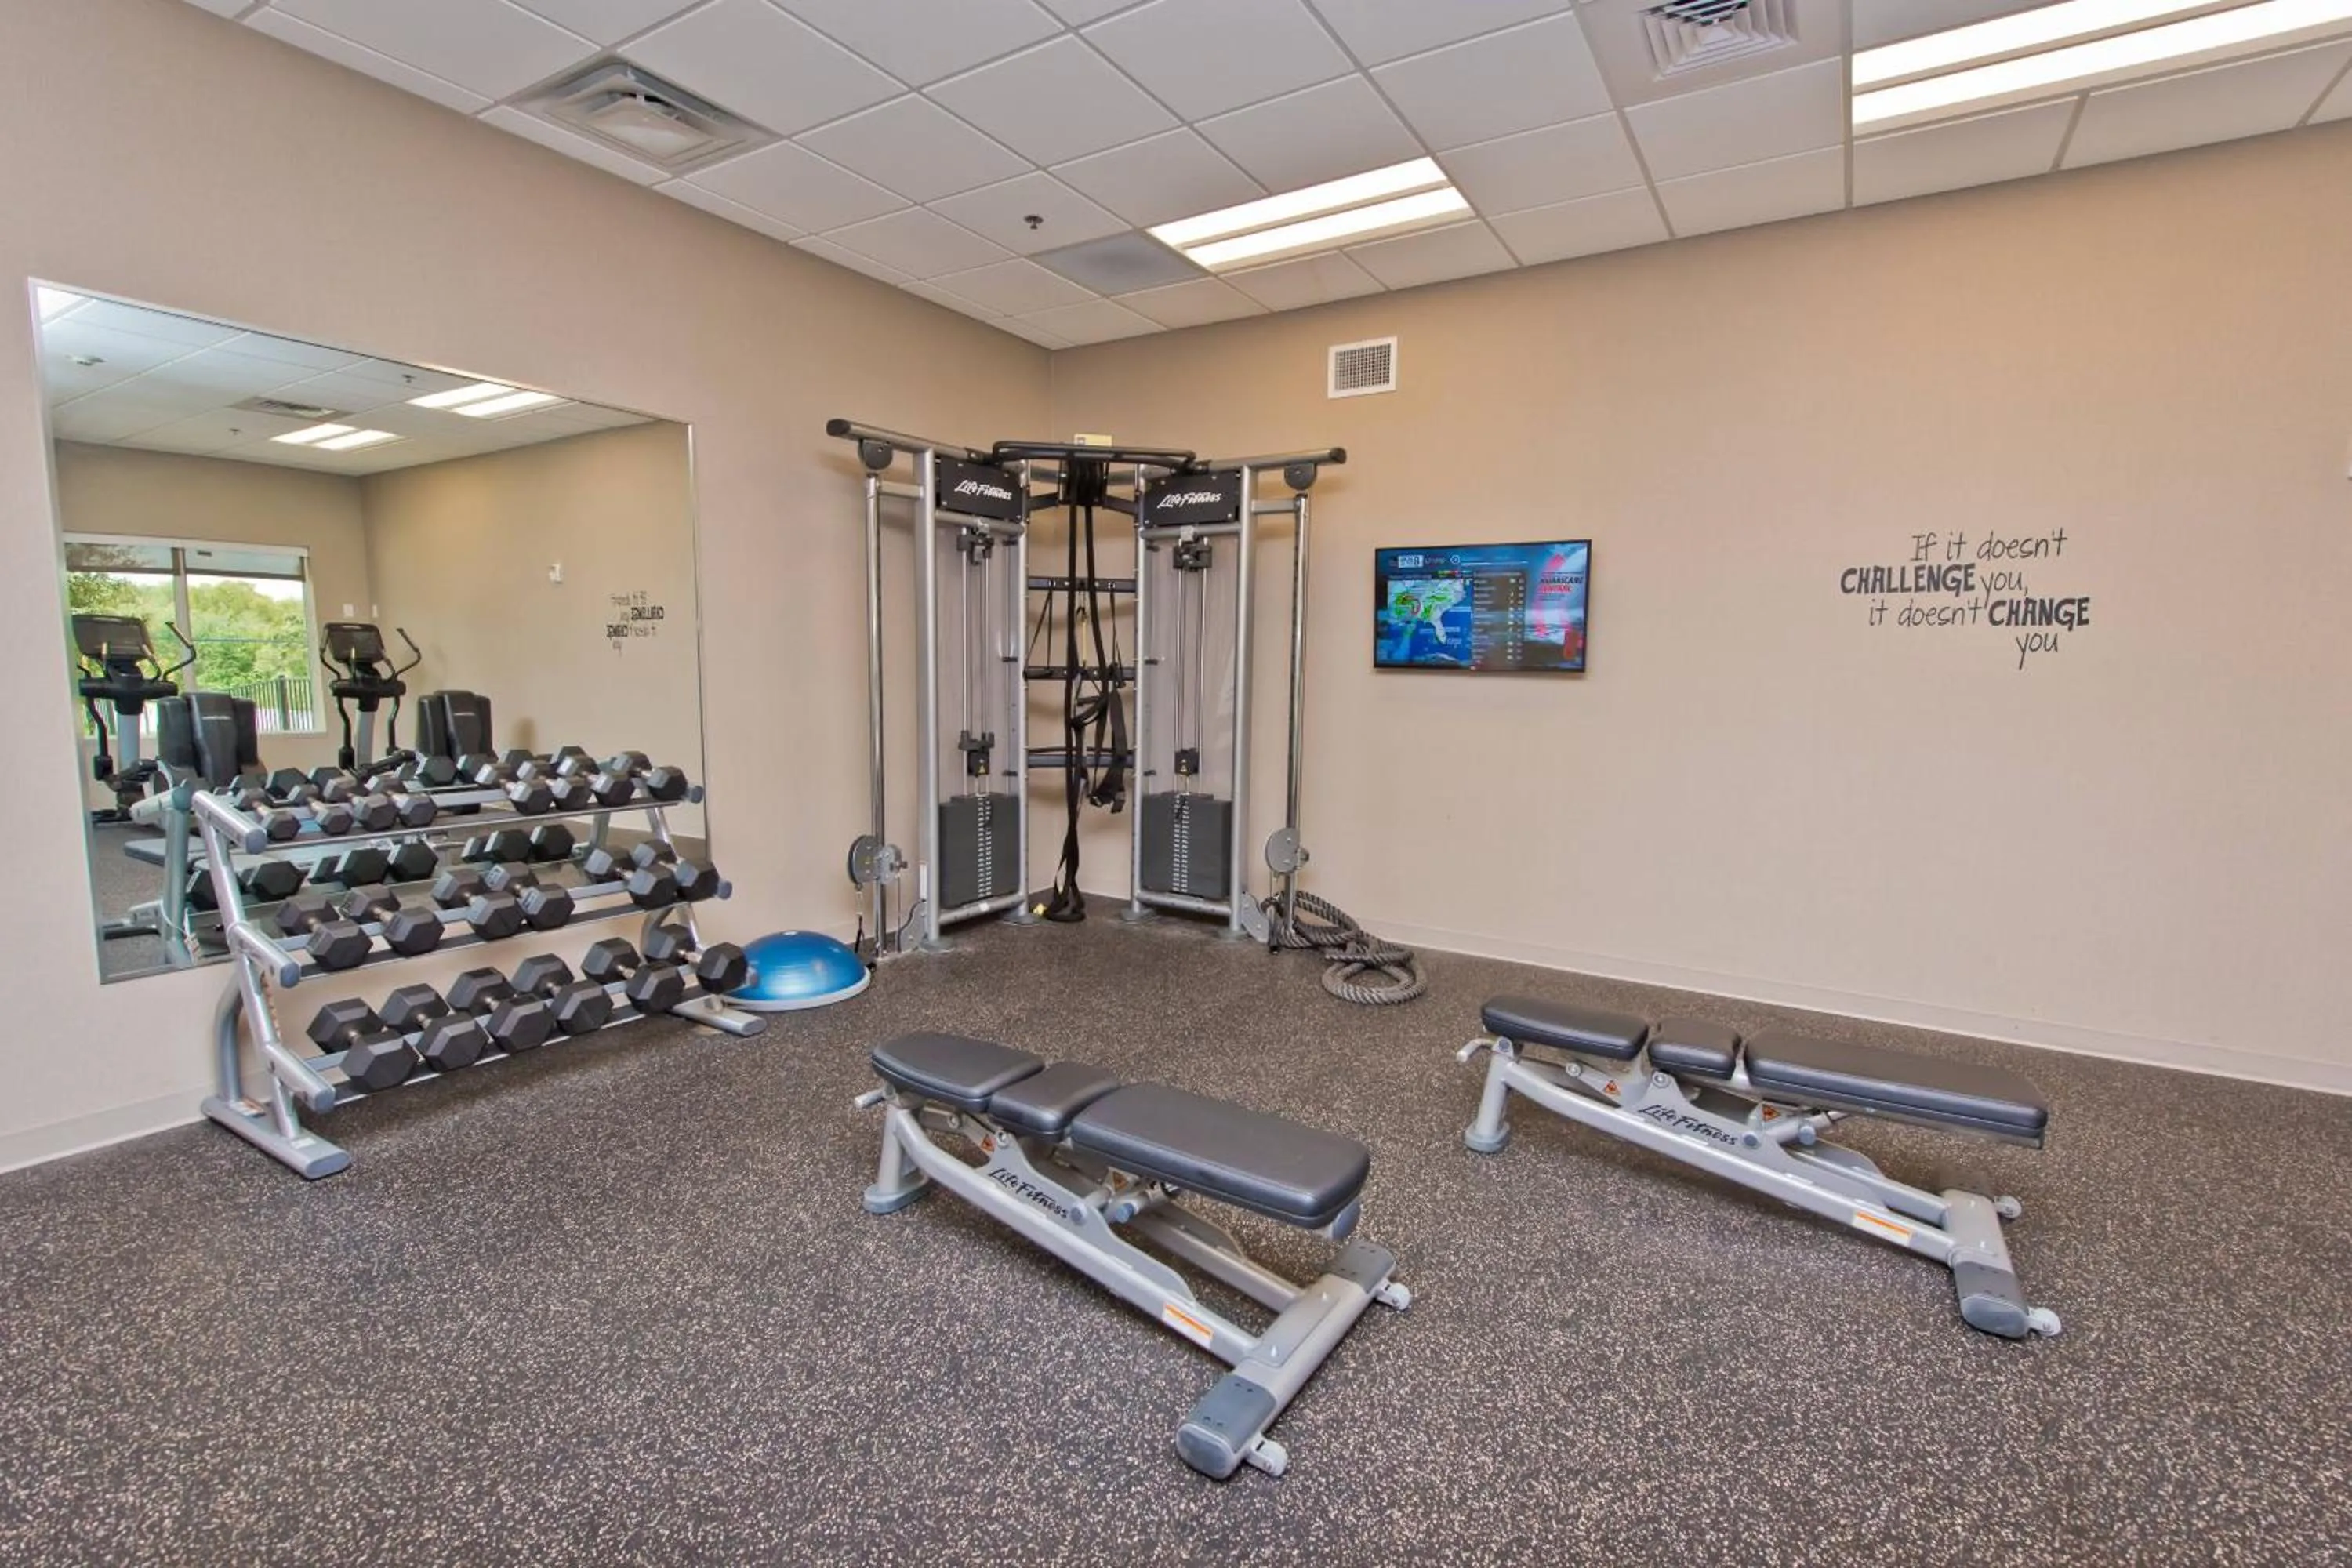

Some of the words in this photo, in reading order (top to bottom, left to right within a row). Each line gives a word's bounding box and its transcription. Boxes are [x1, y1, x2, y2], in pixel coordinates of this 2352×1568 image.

[954, 479, 978, 495] Life
[976, 484, 1012, 501] Fitness
[1156, 494, 1181, 509] Life
[1178, 492, 1222, 508] Fitness
[1910, 532, 1937, 561] If
[1947, 532, 1967, 561] it
[1976, 528, 2068, 561] doesn't
[1840, 563, 1976, 597] CHALLENGE
[1869, 598, 1889, 626] it
[1897, 597, 1982, 626] doesn't
[1988, 597, 2090, 631] CHANGE
[2016, 632, 2059, 670] you
[1637, 1105, 1675, 1122] Life
[1672, 1115, 1738, 1145] Fitness
[988, 1167, 1019, 1188] Life
[1015, 1181, 1068, 1218] Fitness
